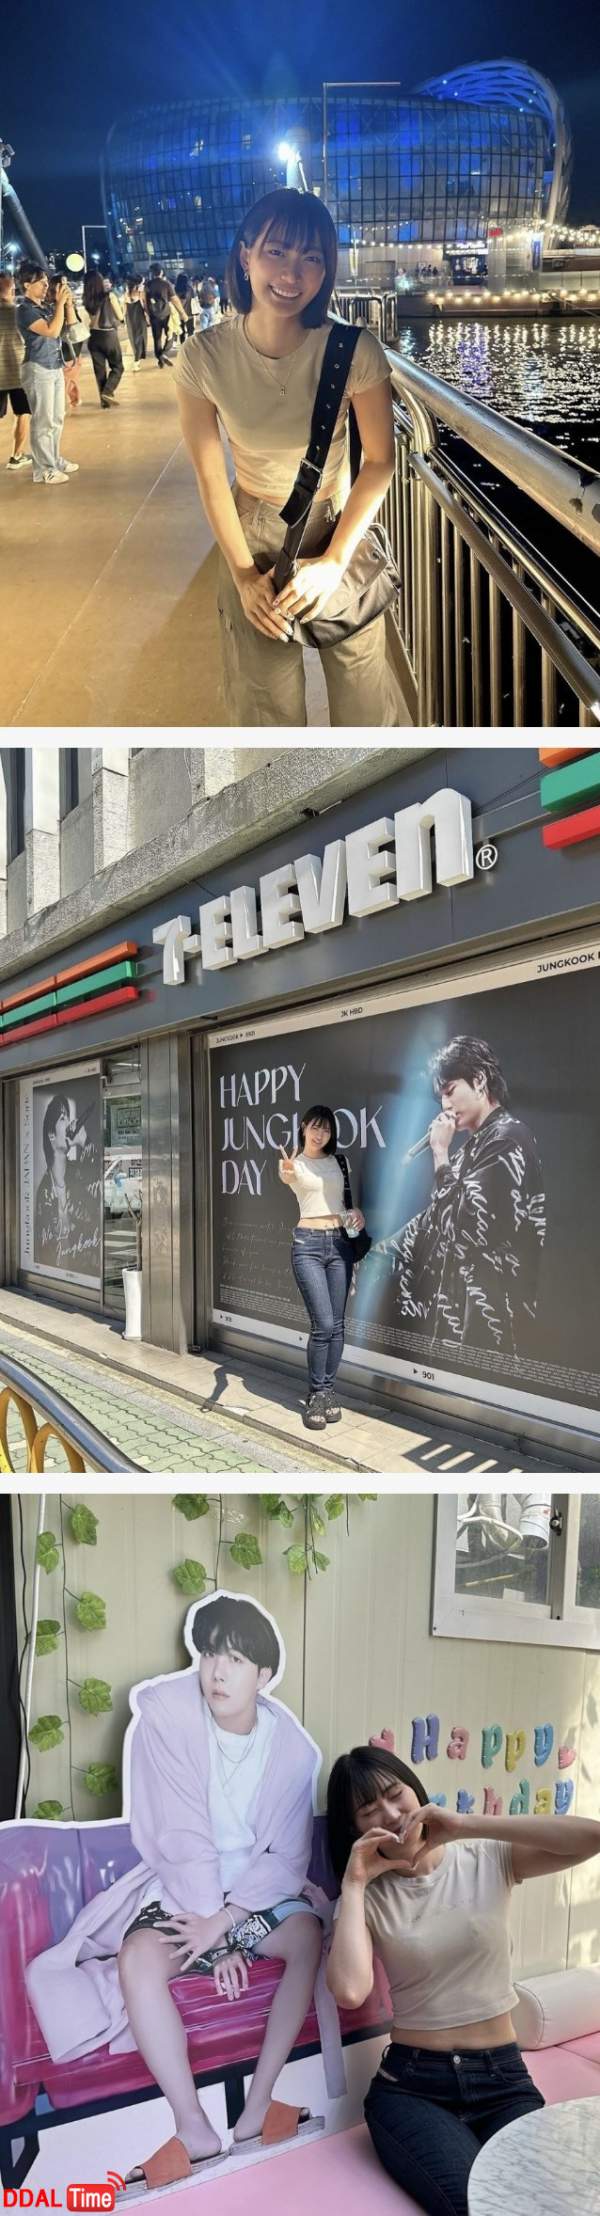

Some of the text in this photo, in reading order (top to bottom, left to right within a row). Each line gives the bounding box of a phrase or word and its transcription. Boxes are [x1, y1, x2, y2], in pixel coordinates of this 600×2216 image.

[537, 952, 595, 973] JUNGKOOK
[220, 1062, 307, 1109] HAPPY
[222, 1105, 386, 1151] JUNGOK
[222, 1159, 267, 1196] DAY
[411, 1713, 553, 1773] Happy
